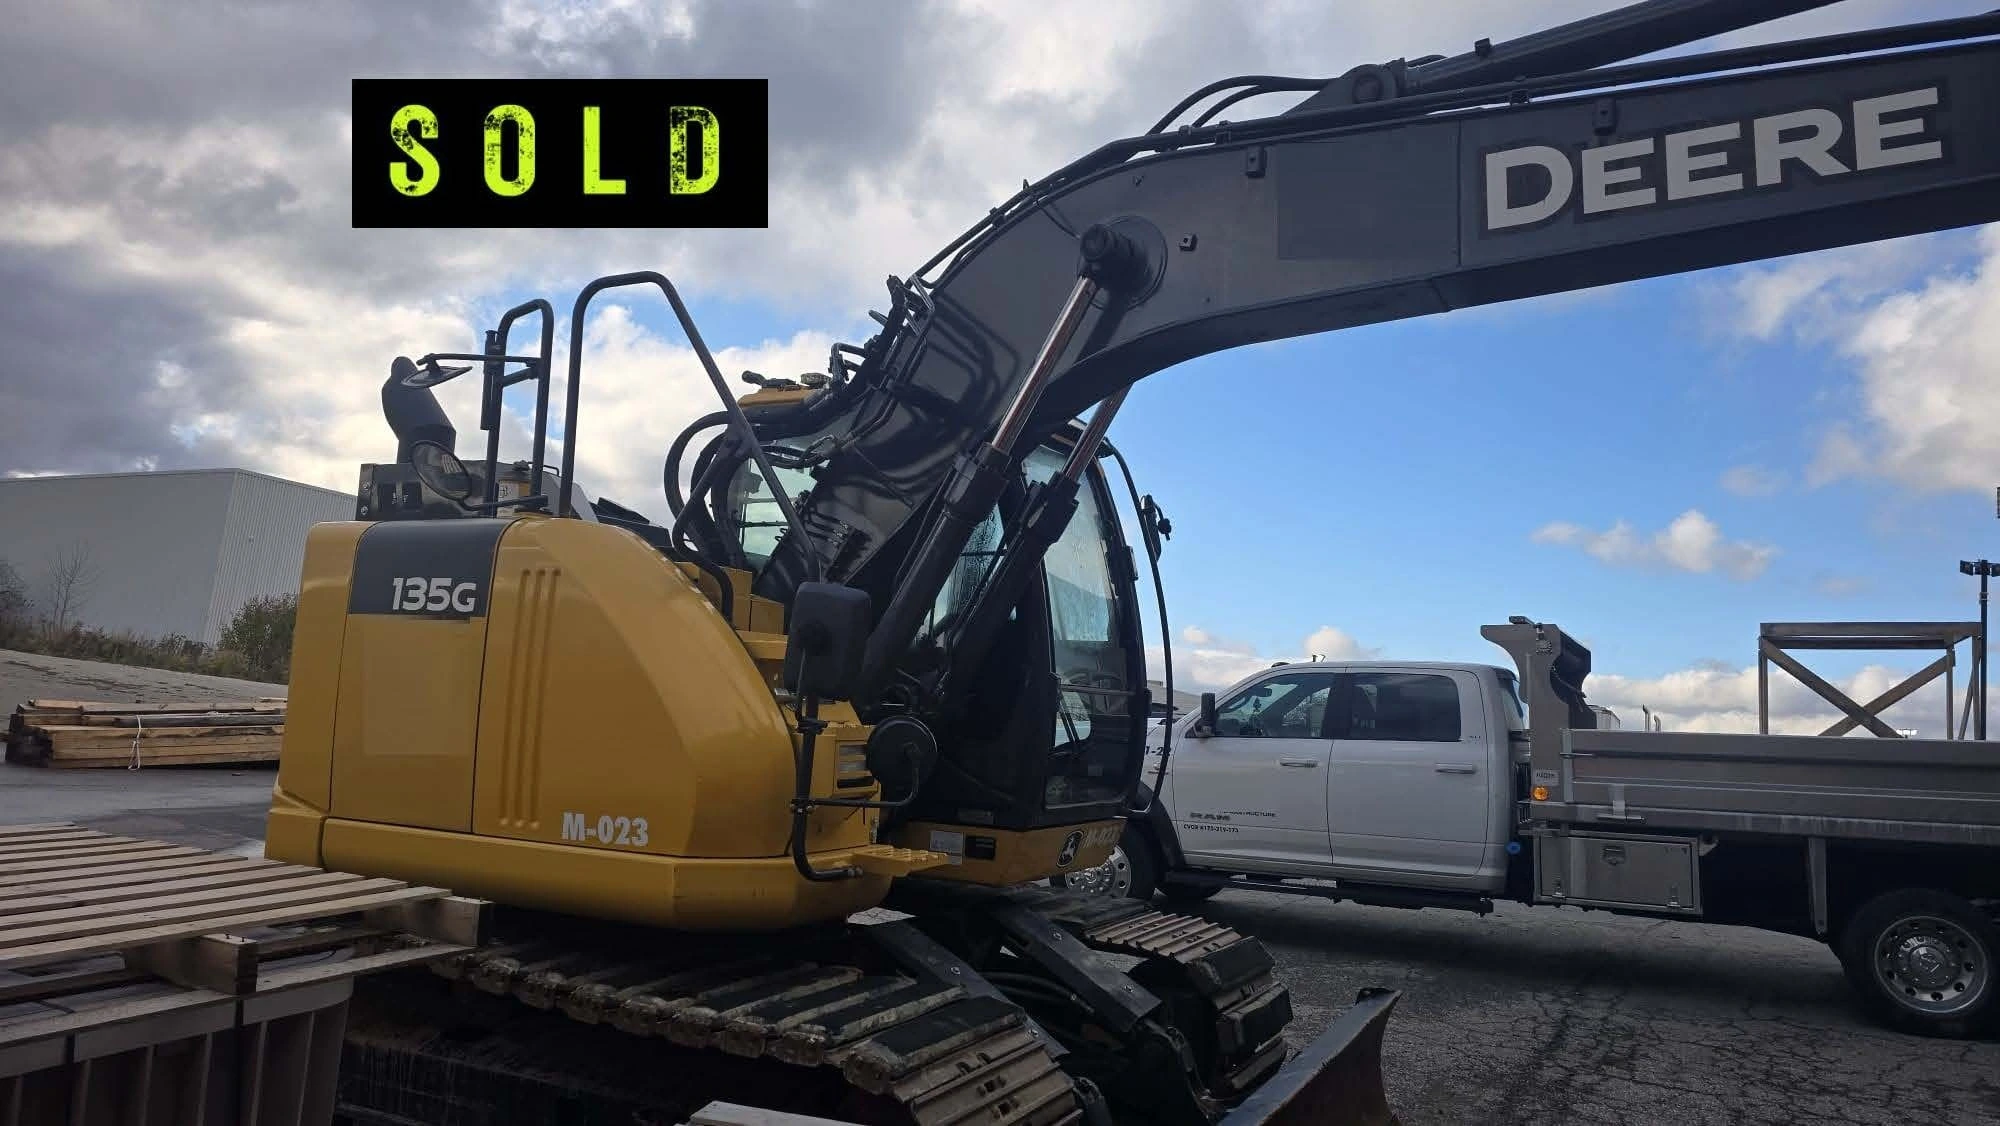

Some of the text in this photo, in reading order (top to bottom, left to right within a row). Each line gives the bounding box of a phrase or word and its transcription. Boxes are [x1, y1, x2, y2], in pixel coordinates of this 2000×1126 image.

[1485, 87, 1943, 230] DEERE
[392, 576, 477, 613] 135G
[562, 812, 649, 847] M-023
